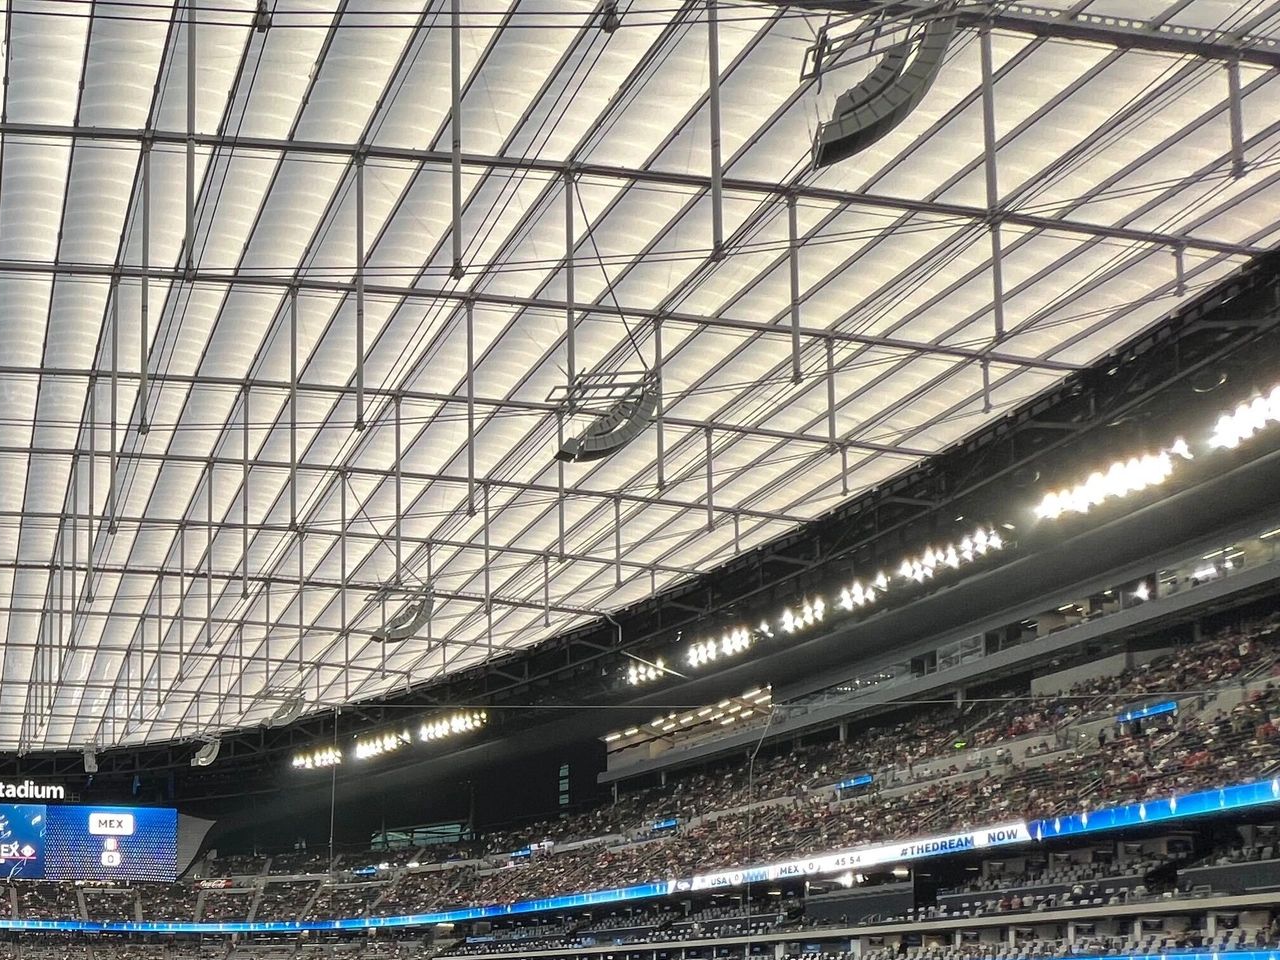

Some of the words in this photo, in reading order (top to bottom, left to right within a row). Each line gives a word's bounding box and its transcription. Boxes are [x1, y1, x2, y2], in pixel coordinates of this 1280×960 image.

[98, 819, 124, 829] MEX
[900, 835, 975, 857] #THEDREAM
[987, 829, 1018, 843] NOW
[107, 854, 115, 864] 0
[779, 866, 799, 876] MEX
[711, 877, 727, 886] USA
